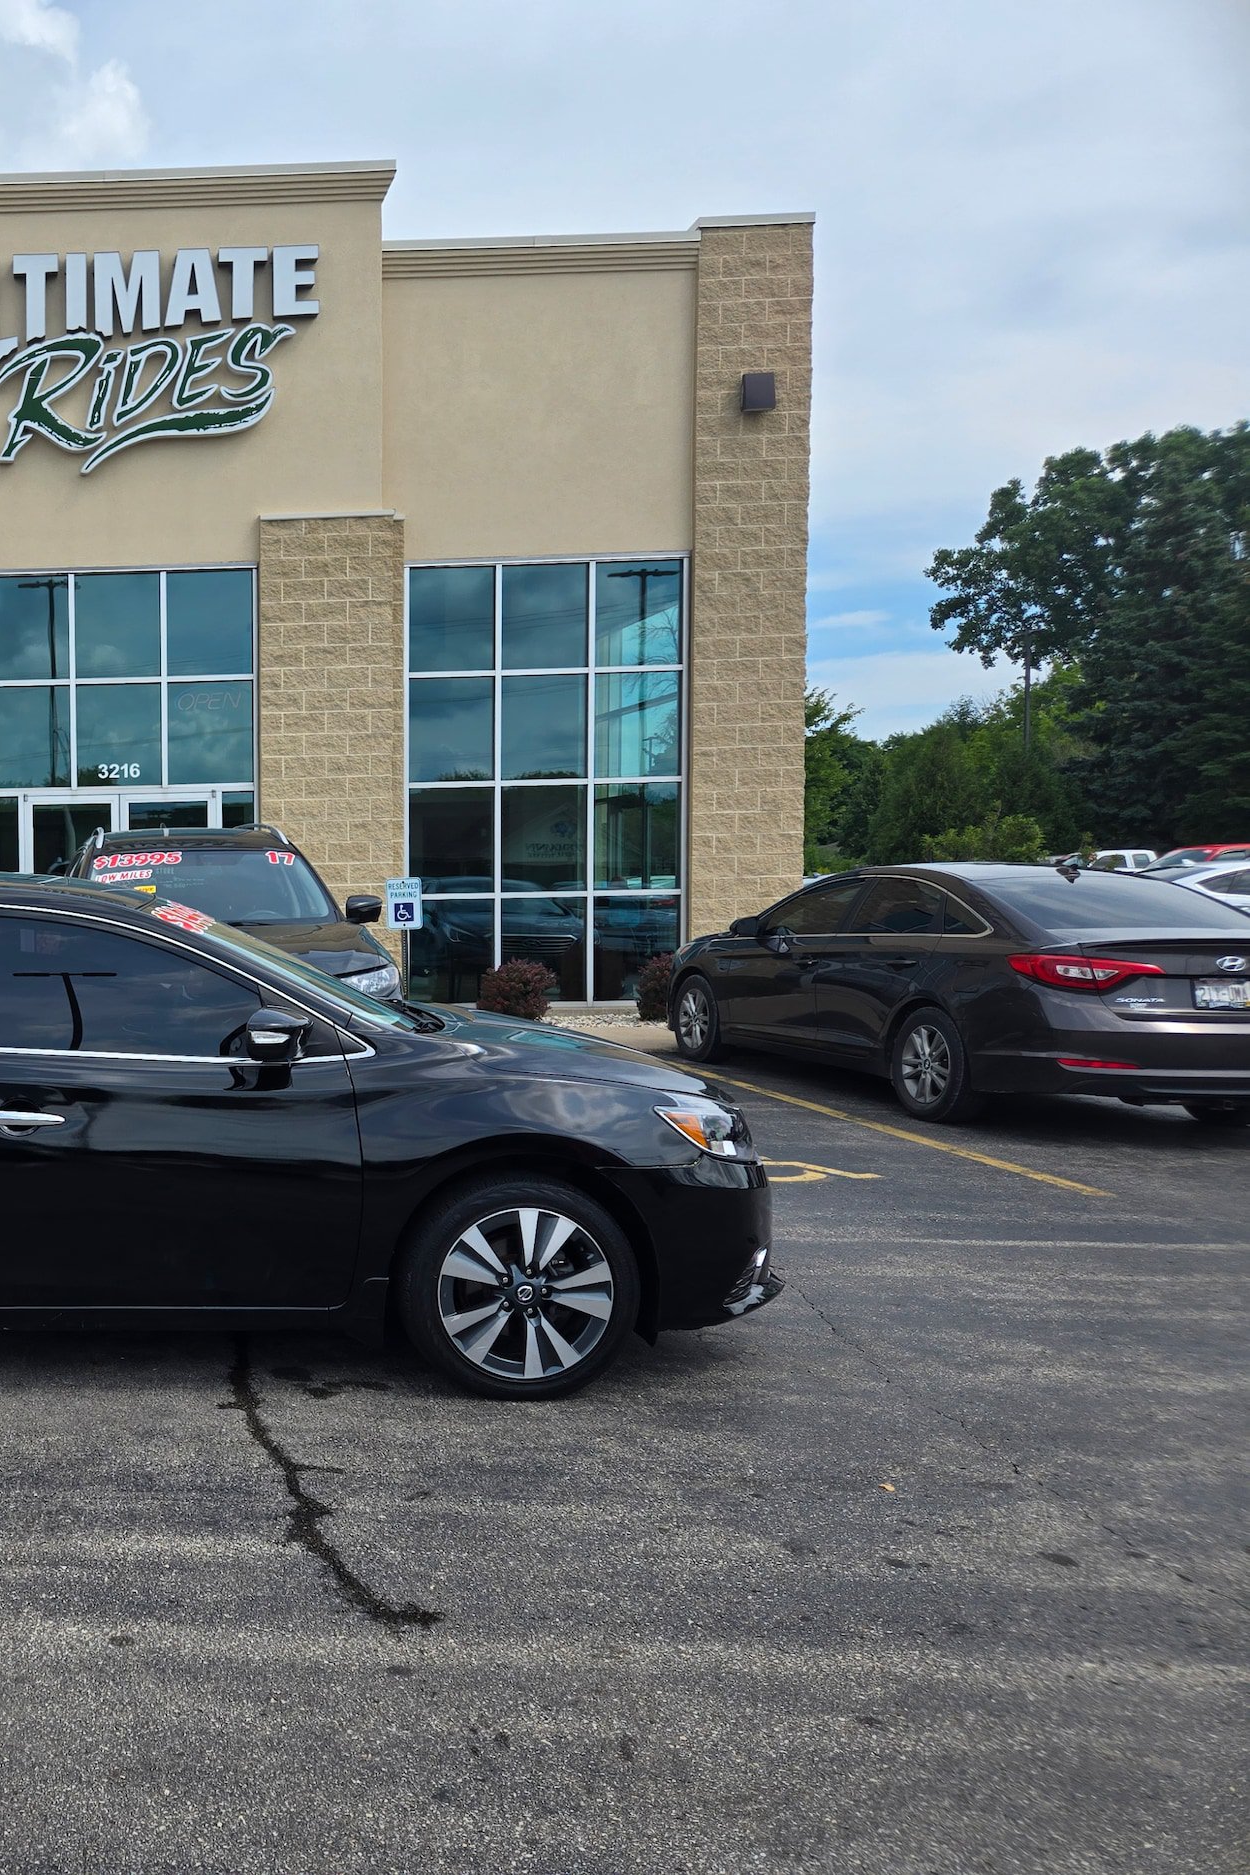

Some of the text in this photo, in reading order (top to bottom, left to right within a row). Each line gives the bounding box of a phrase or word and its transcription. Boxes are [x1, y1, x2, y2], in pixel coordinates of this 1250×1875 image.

[177, 690, 242, 711] OPEN
[98, 763, 141, 779] 3216
[93, 852, 182, 870] $13995
[265, 851, 295, 866] 17
[119, 869, 153, 881] MILES
[388, 882, 418, 890] RESERVED
[390, 891, 417, 899] PARKING
[1115, 996, 1165, 1004] SONATA
